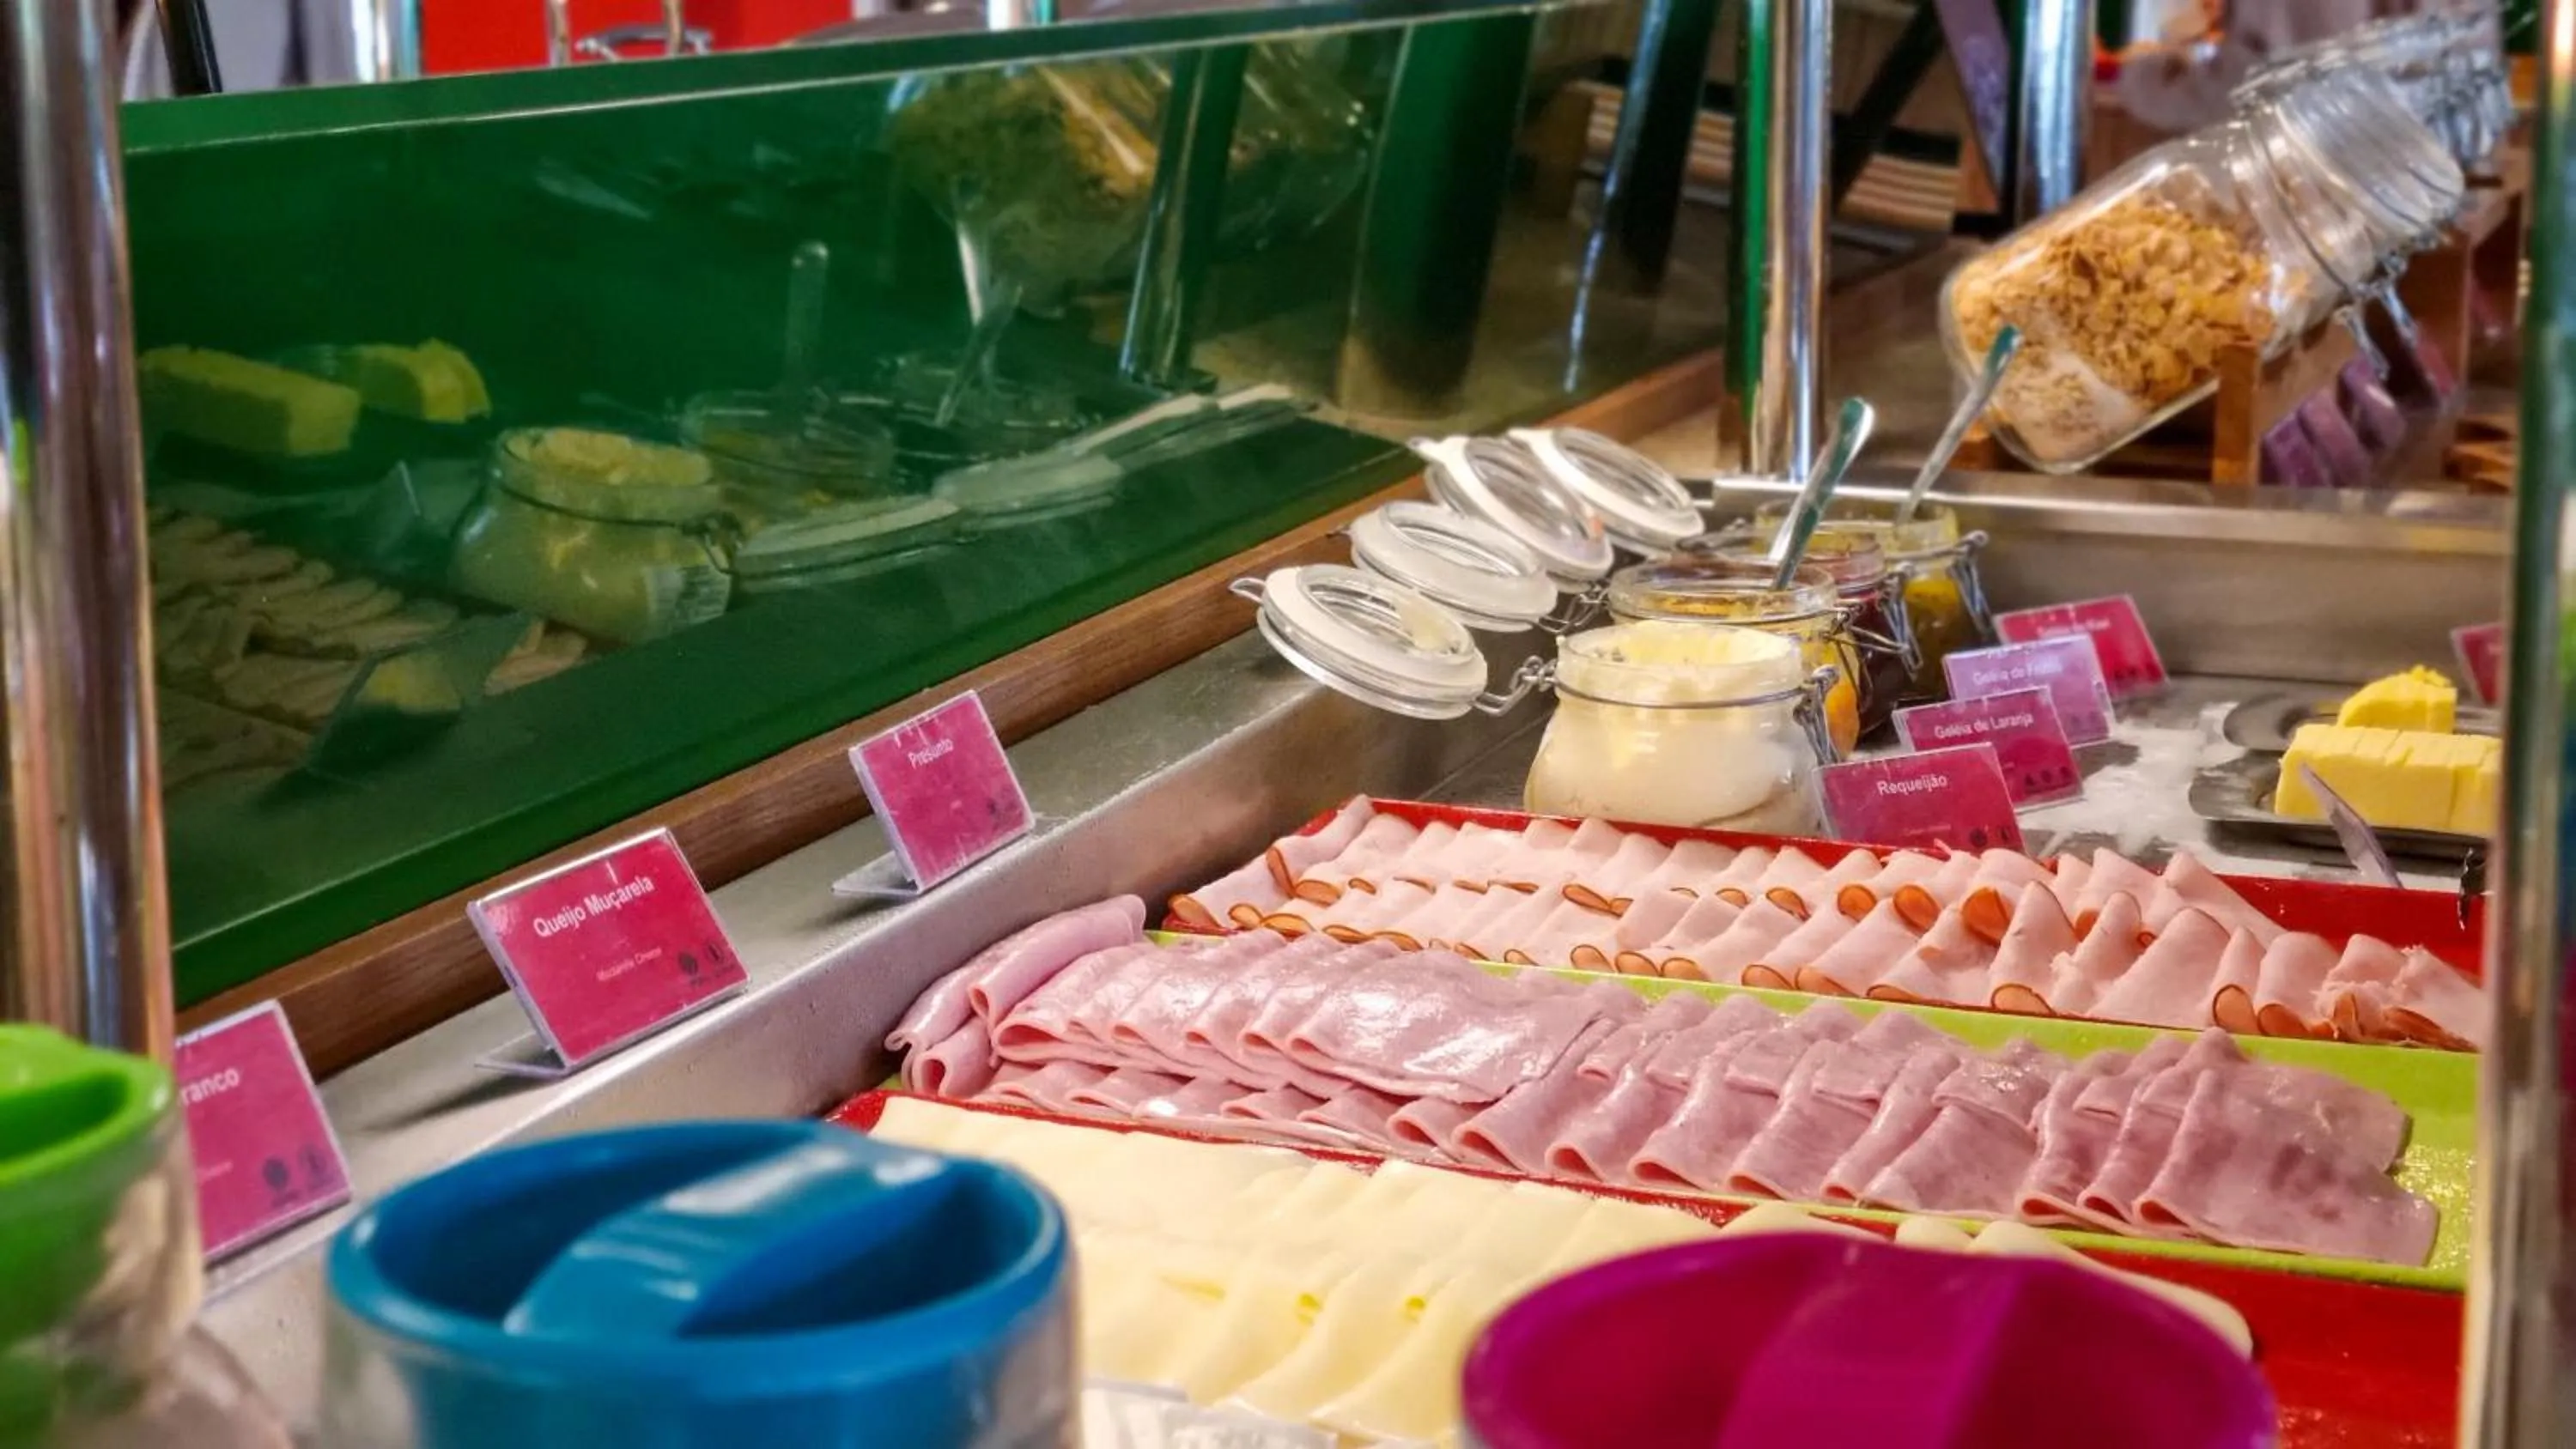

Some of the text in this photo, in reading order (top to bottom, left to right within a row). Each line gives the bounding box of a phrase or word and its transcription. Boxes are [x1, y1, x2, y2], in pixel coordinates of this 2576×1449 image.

[1973, 717, 1990, 733] de
[1990, 712, 2034, 730] Laranja
[908, 738, 953, 769] Presunto
[1876, 773, 1947, 797] Requeijão
[533, 875, 654, 937] Queijo Muçarela
[181, 1067, 240, 1106] ranco
